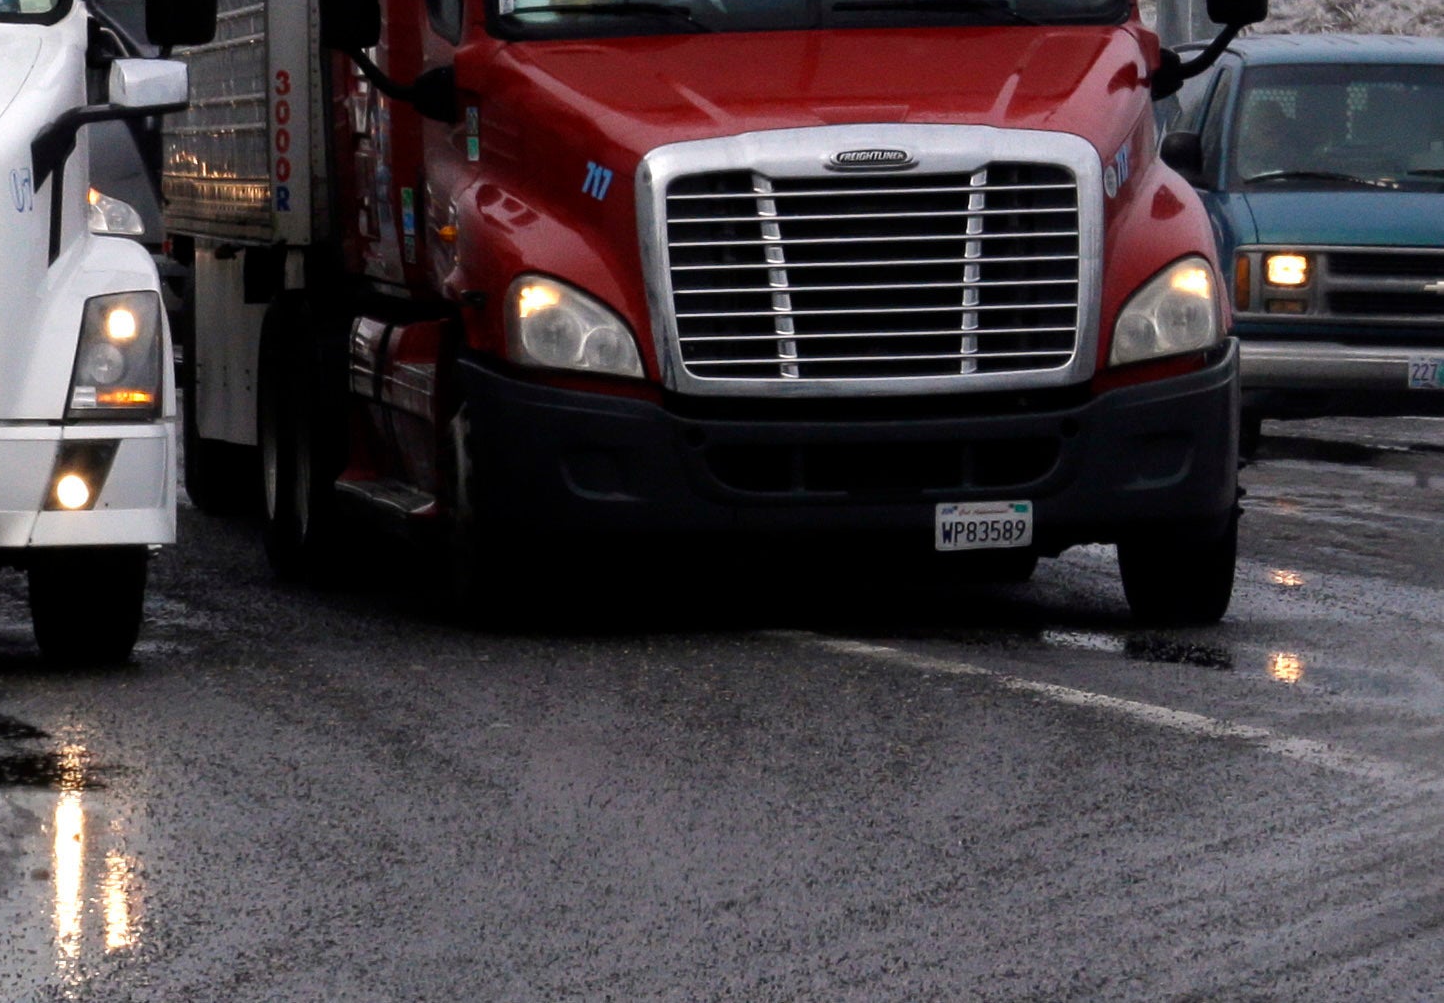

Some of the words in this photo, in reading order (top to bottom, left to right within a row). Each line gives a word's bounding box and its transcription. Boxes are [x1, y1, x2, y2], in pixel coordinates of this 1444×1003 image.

[275, 69, 291, 212] 3000R
[839, 151, 904, 161] FREIGHTLINER
[581, 160, 613, 201] 717
[941, 519, 1026, 544] WP83589
